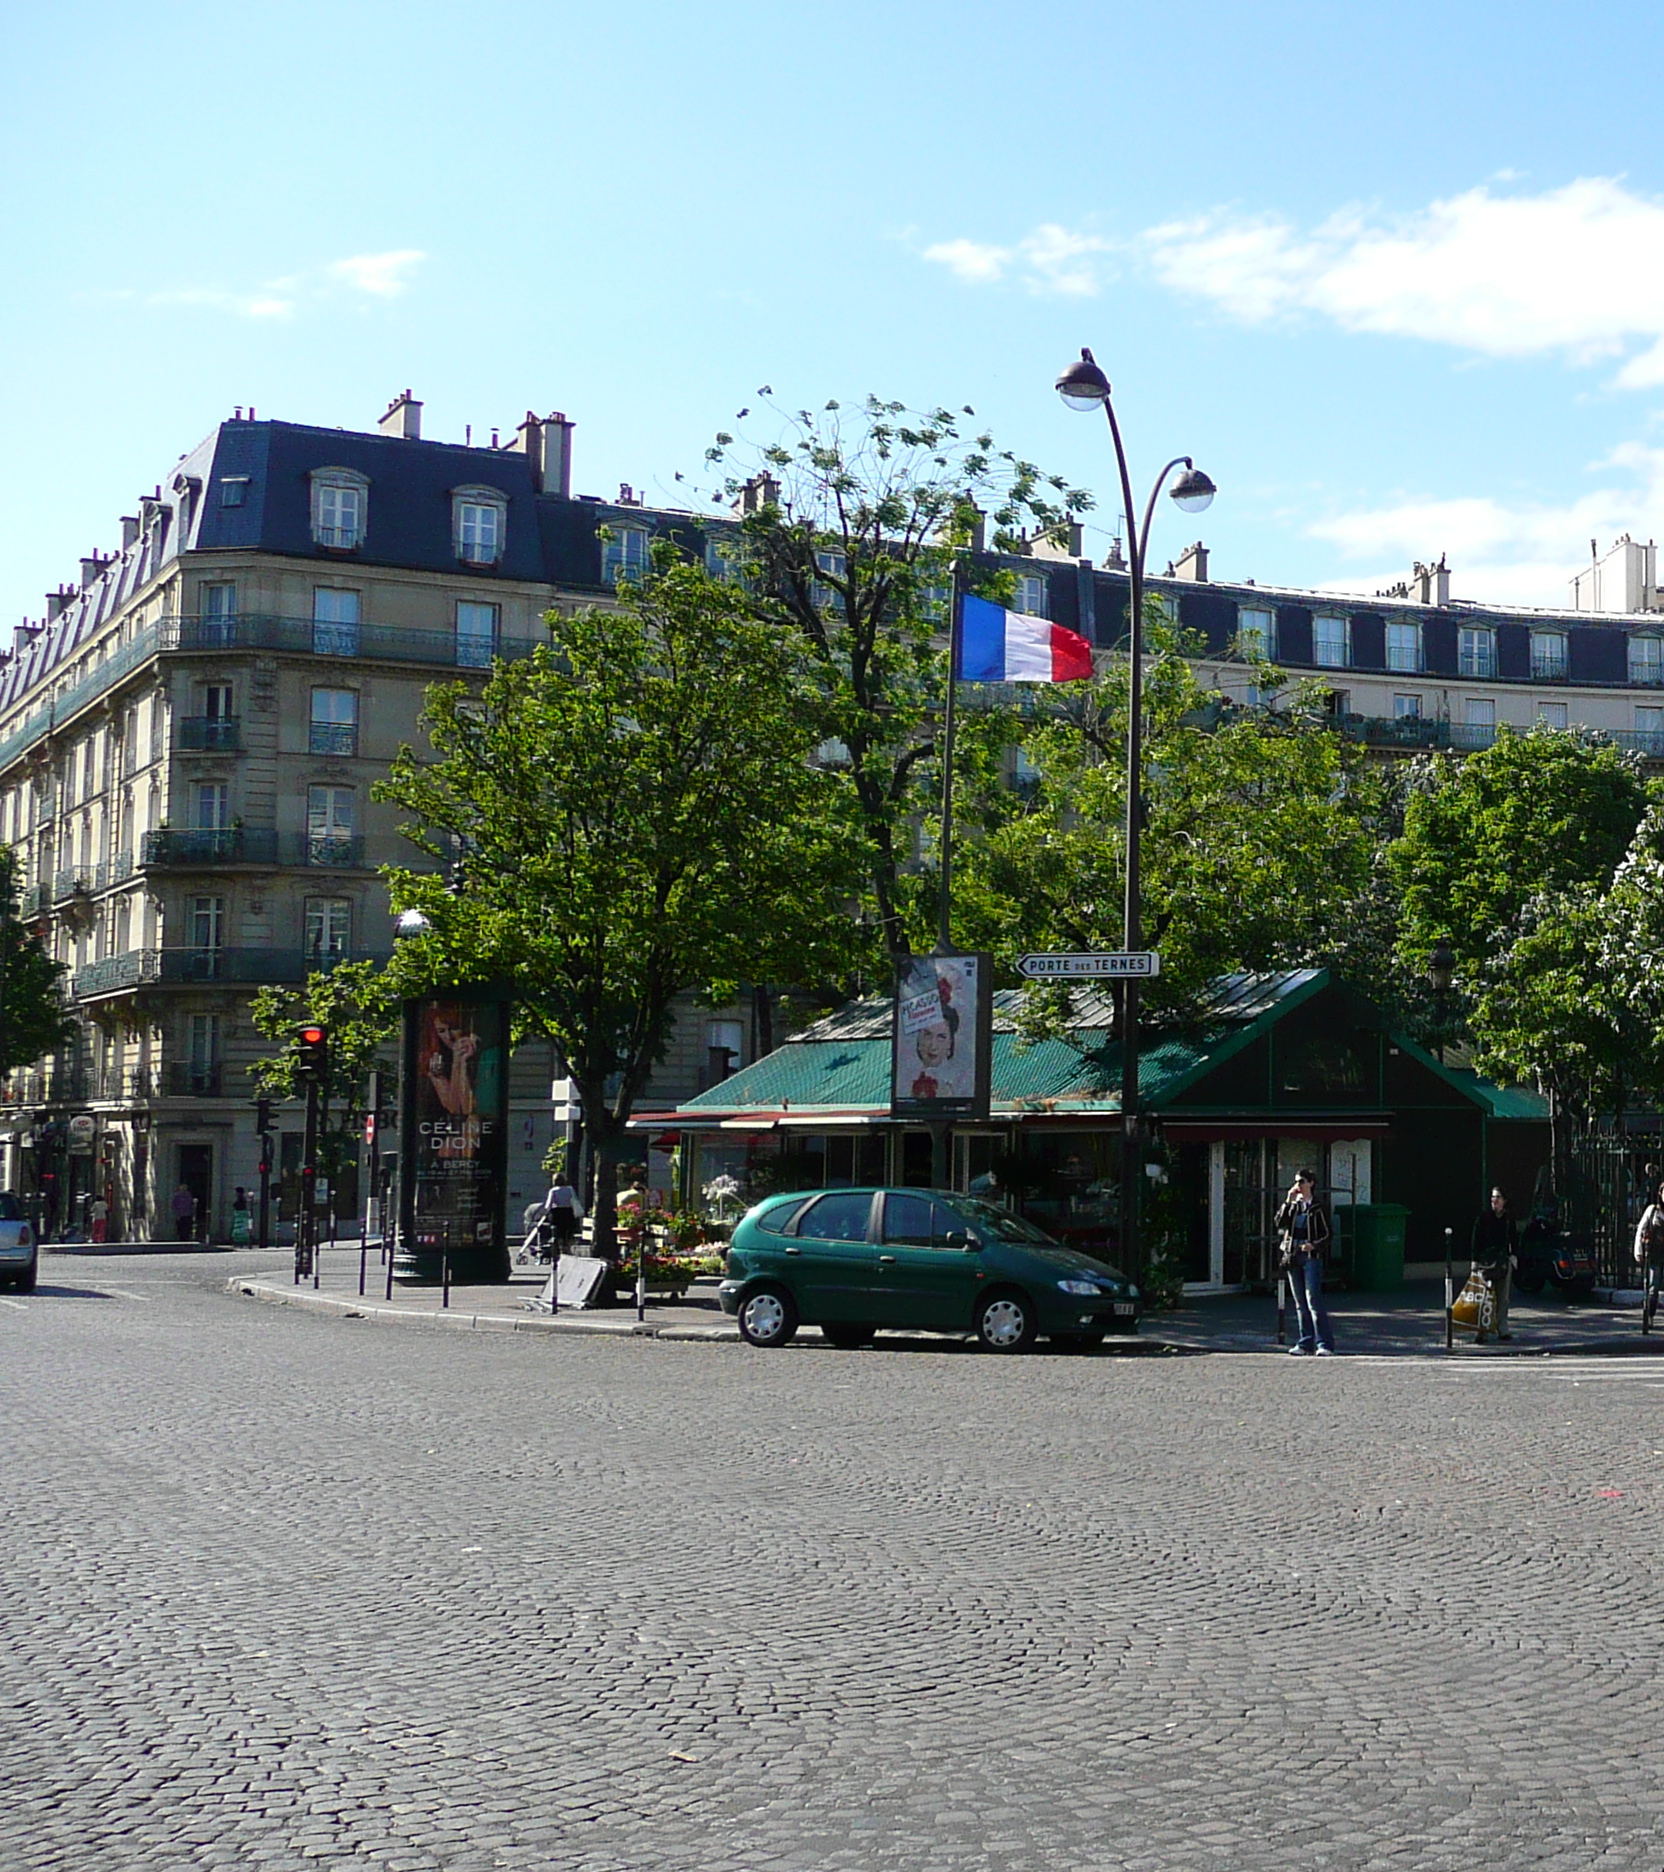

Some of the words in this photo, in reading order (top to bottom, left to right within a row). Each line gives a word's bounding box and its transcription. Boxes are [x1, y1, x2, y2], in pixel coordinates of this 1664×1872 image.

[1029, 960, 1070, 971] PORTE
[1074, 962, 1091, 971] DES
[1094, 958, 1145, 970] TERNES
[419, 1117, 493, 1134] CÉLINE
[430, 1137, 481, 1150] DION
[443, 1160, 481, 1169] BERCY
